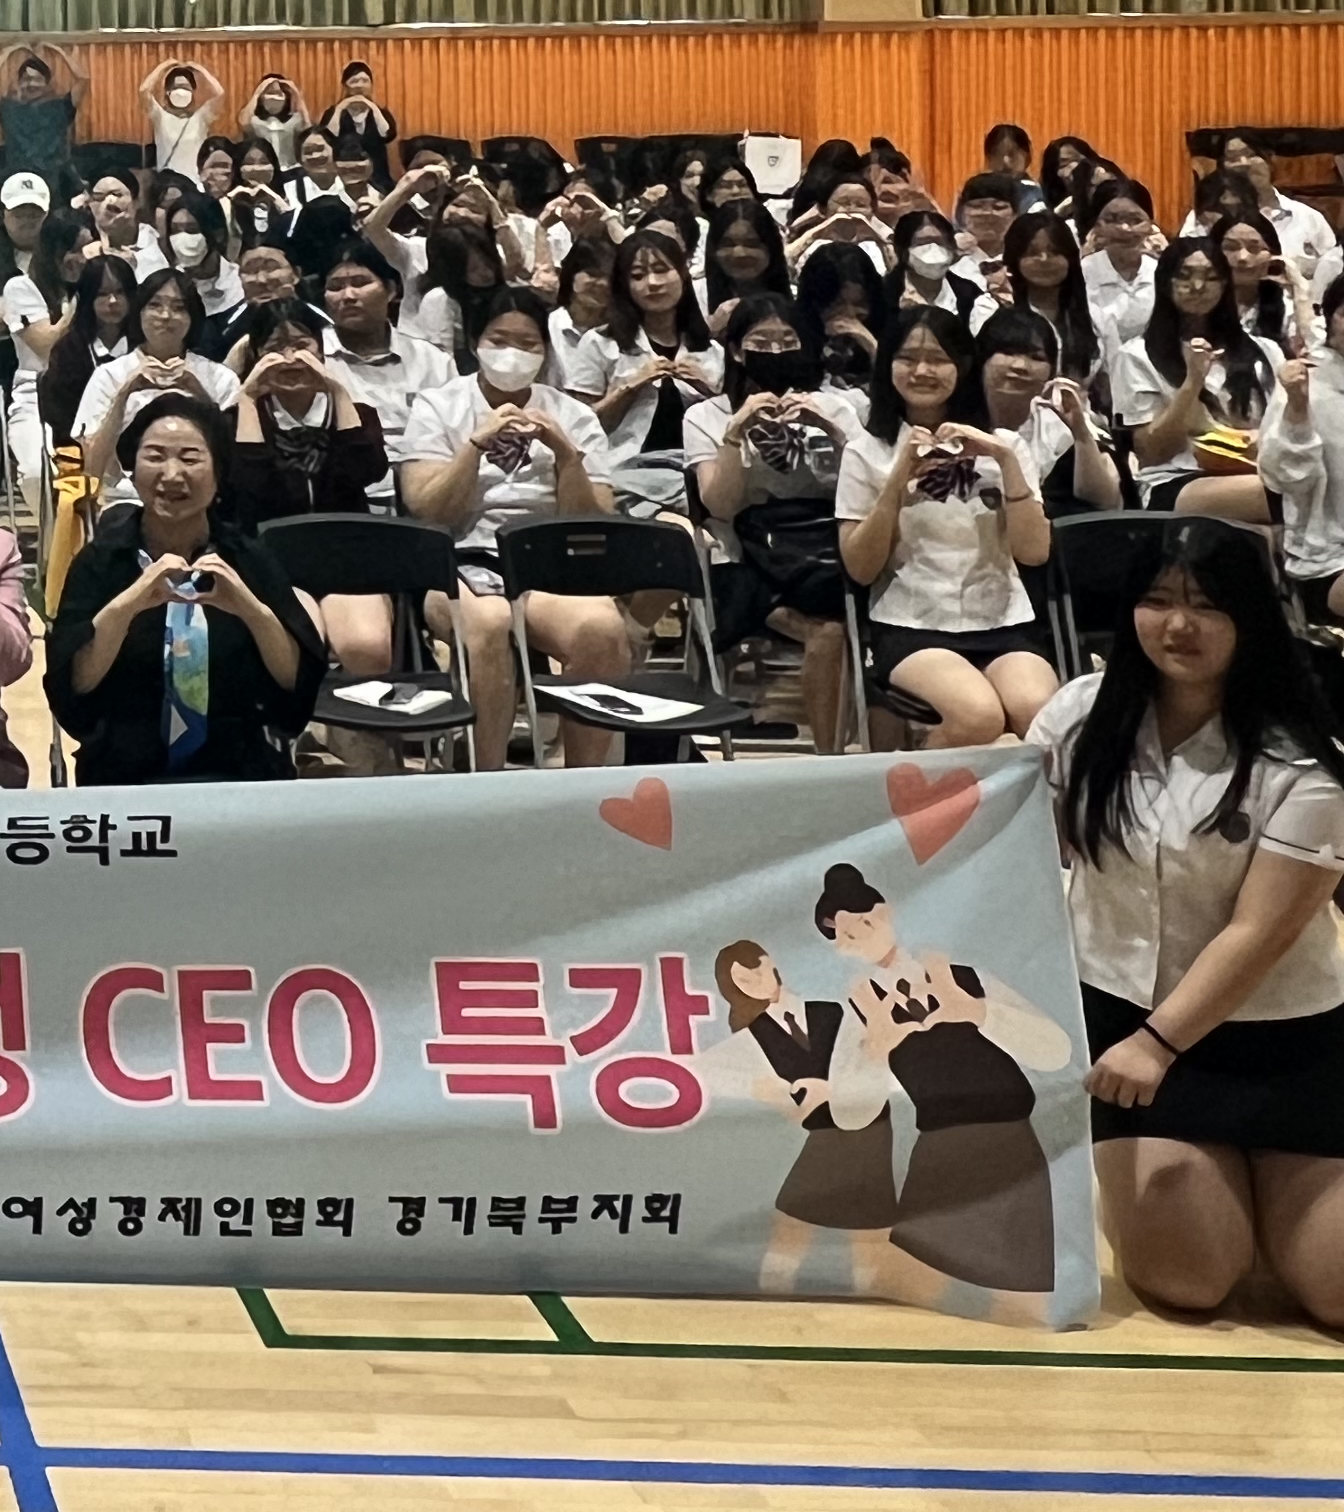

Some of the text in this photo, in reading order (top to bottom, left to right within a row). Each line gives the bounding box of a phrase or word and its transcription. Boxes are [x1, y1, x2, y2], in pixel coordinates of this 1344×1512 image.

[82, 965, 378, 1105] CEO
[426, 955, 711, 1130] 특강
[388, 1193, 682, 1237] 경기북부지회
